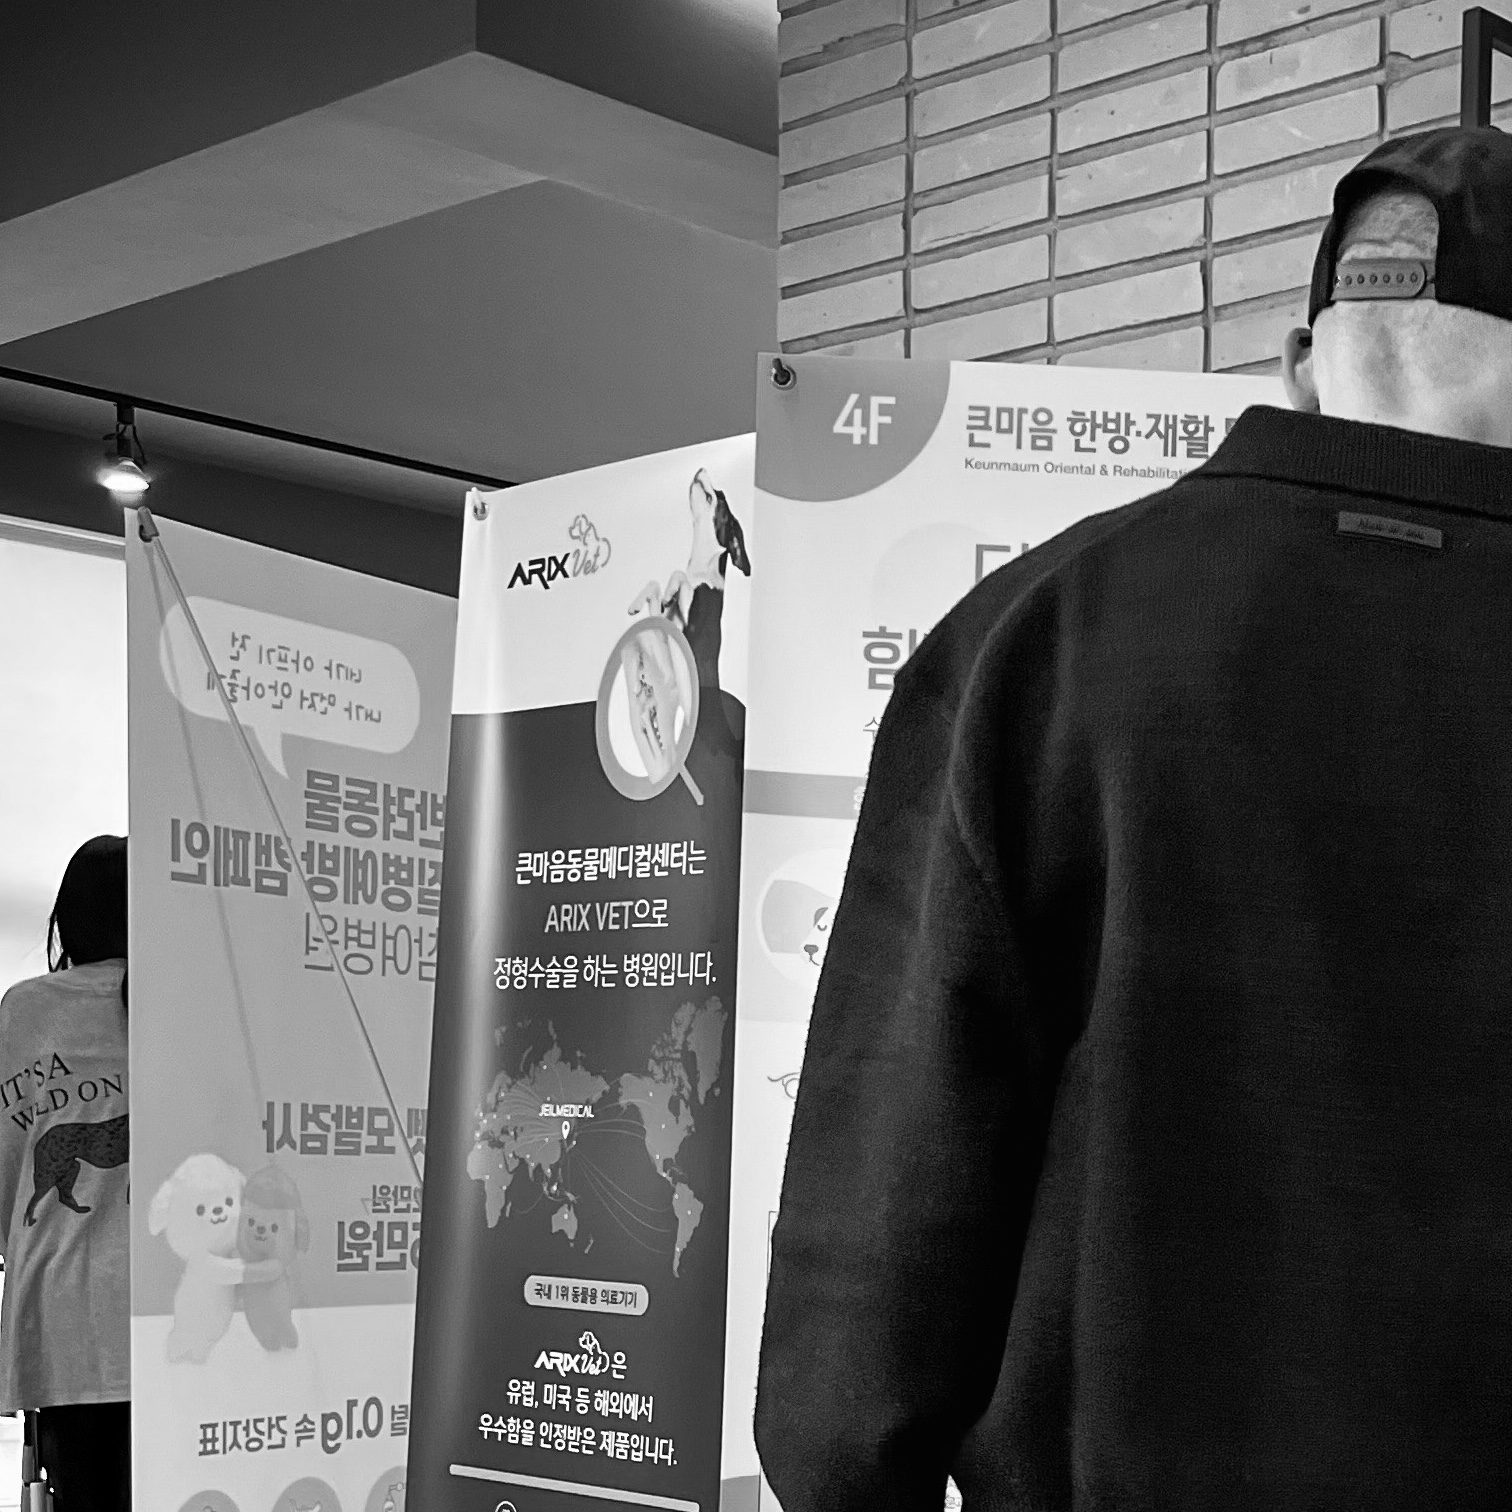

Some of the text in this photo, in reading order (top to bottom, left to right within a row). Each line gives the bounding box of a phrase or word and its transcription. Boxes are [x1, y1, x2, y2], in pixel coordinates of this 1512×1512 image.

[833, 393, 896, 445] 4F
[966, 405, 1057, 450] 큰마음
[1067, 409, 1214, 459] 한방·재활
[964, 458, 1190, 479] Keunmaum Oriental & Rehabilitat
[507, 553, 570, 589] ARIX
[516, 841, 707, 884] 큰마음동물메디컬센터는
[544, 899, 668, 933] ARIX VET으로
[494, 951, 717, 989] 정형수술을 하는 병원입니다.
[48, 1052, 73, 1080] A
[539, 1104, 594, 1119] JEILMEDICAL
[601, 1288, 638, 1309] 의료기기
[507, 1379, 653, 1422] 유럽, 미국 등 해외에서
[478, 1414, 678, 1466] 우수함을 인정받은 제품입니다.
